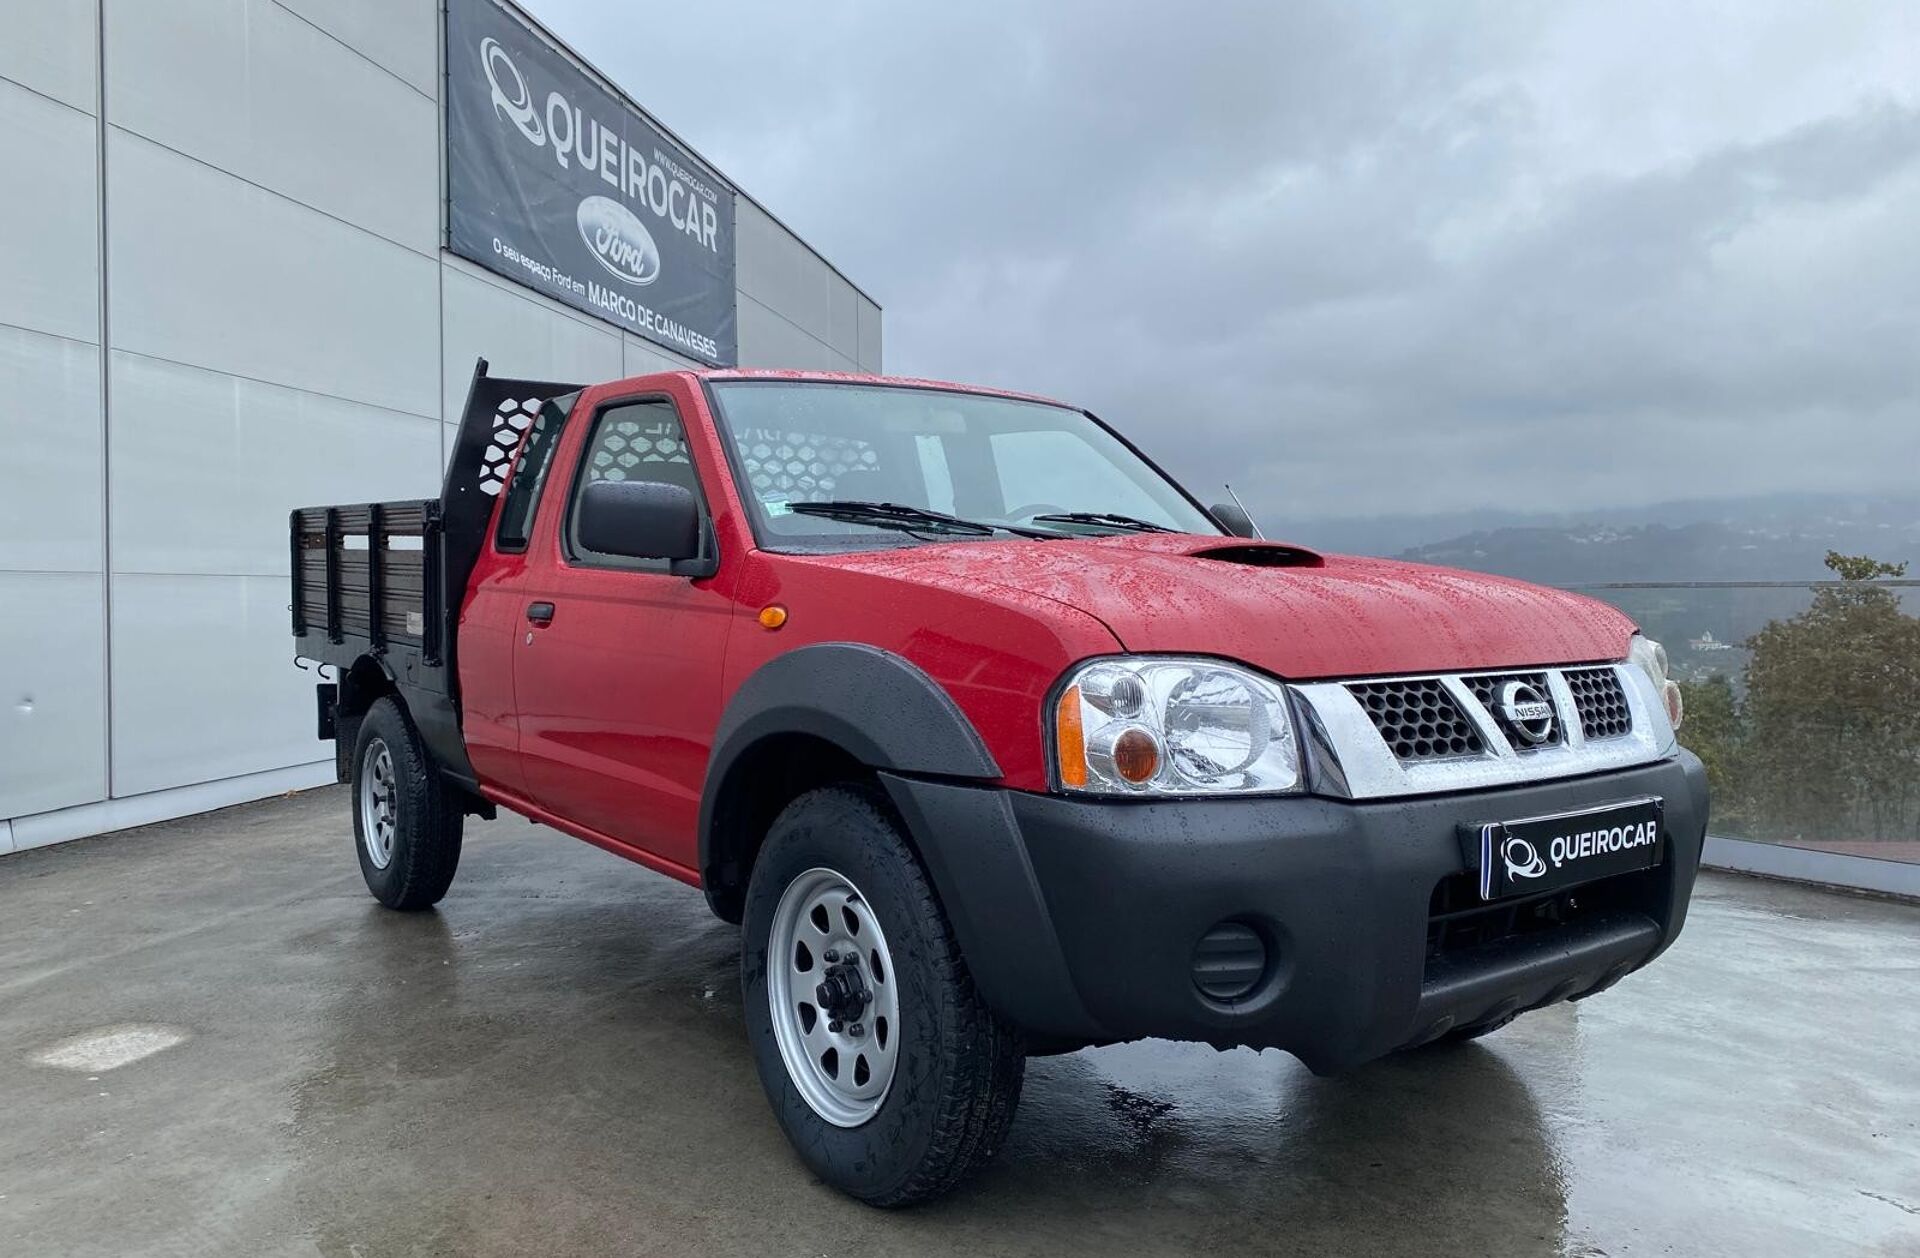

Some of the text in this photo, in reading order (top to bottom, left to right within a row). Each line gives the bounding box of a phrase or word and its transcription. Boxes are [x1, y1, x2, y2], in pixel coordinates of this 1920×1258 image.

[546, 91, 718, 253] QUEIROCAR
[595, 221, 645, 277] Ford
[493, 237, 718, 358] O seu espaço Ford em MARCO DE CANAVESES
[1515, 704, 1550, 719] NISSAN
[1550, 820, 1657, 868] QUEIROCAR
